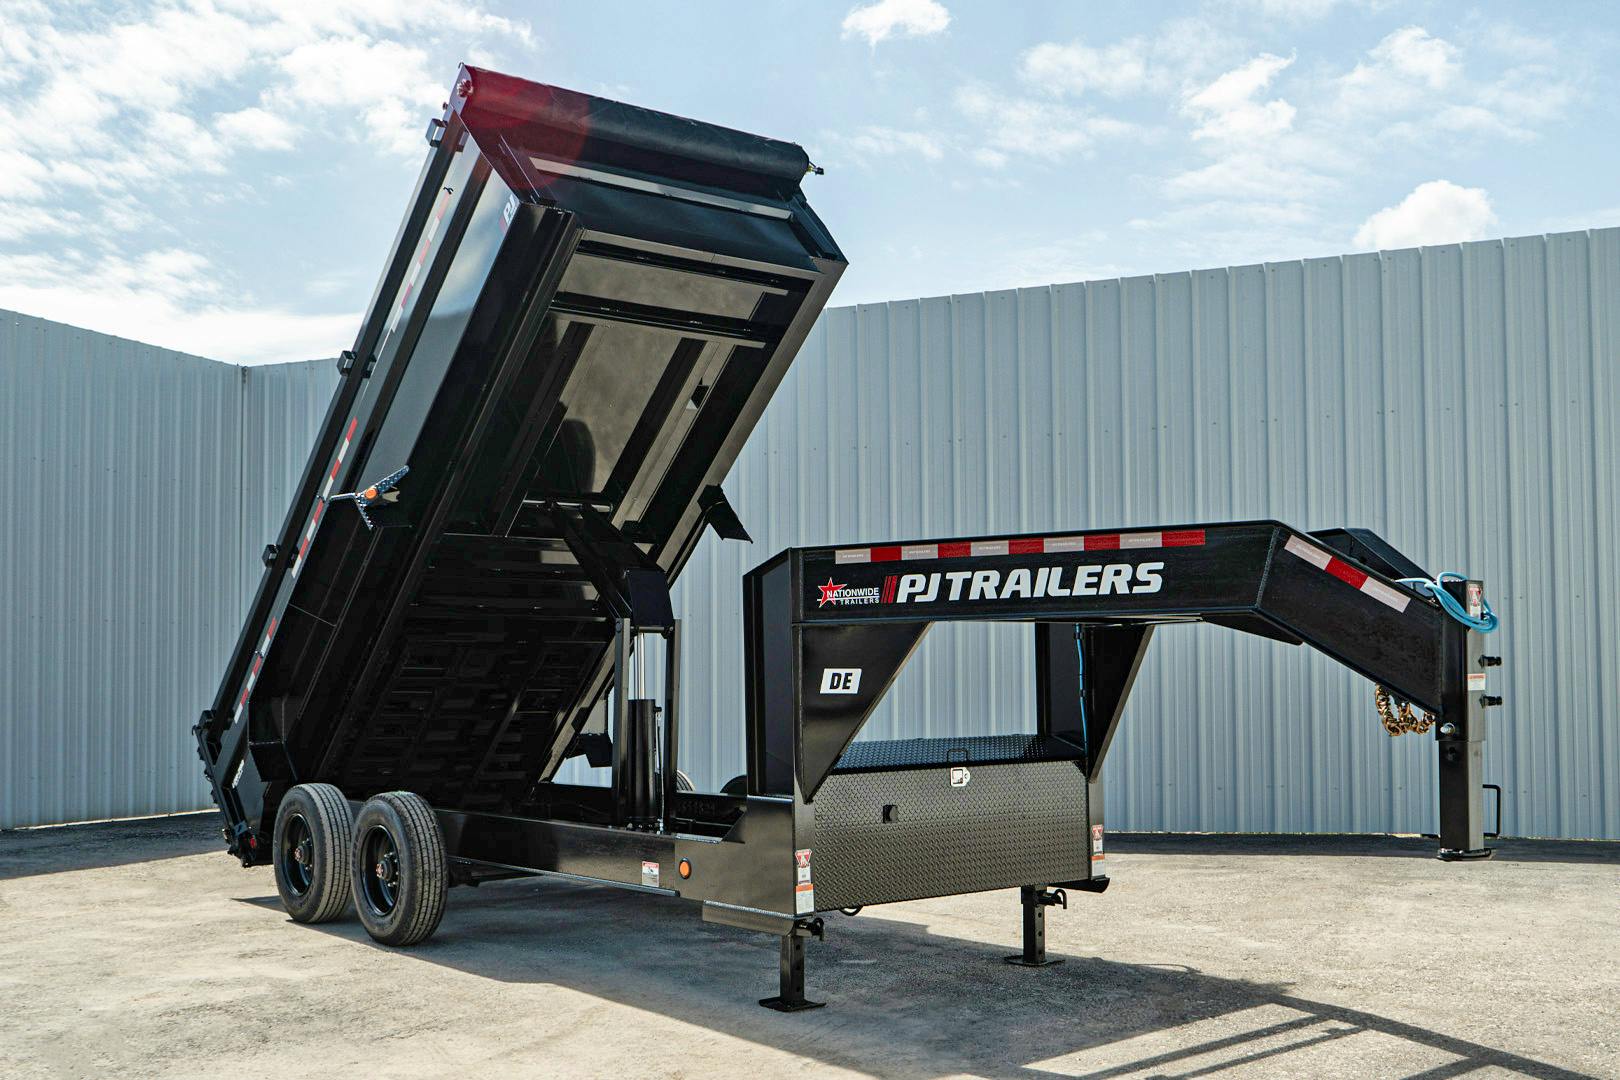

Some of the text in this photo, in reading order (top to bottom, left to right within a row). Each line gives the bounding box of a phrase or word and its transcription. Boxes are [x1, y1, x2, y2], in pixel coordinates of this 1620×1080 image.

[896, 561, 1165, 603] PJ TRAILERS
[827, 587, 880, 598] NATIONWIDE
[840, 597, 880, 606] TRAILERS
[829, 672, 853, 690] DE
